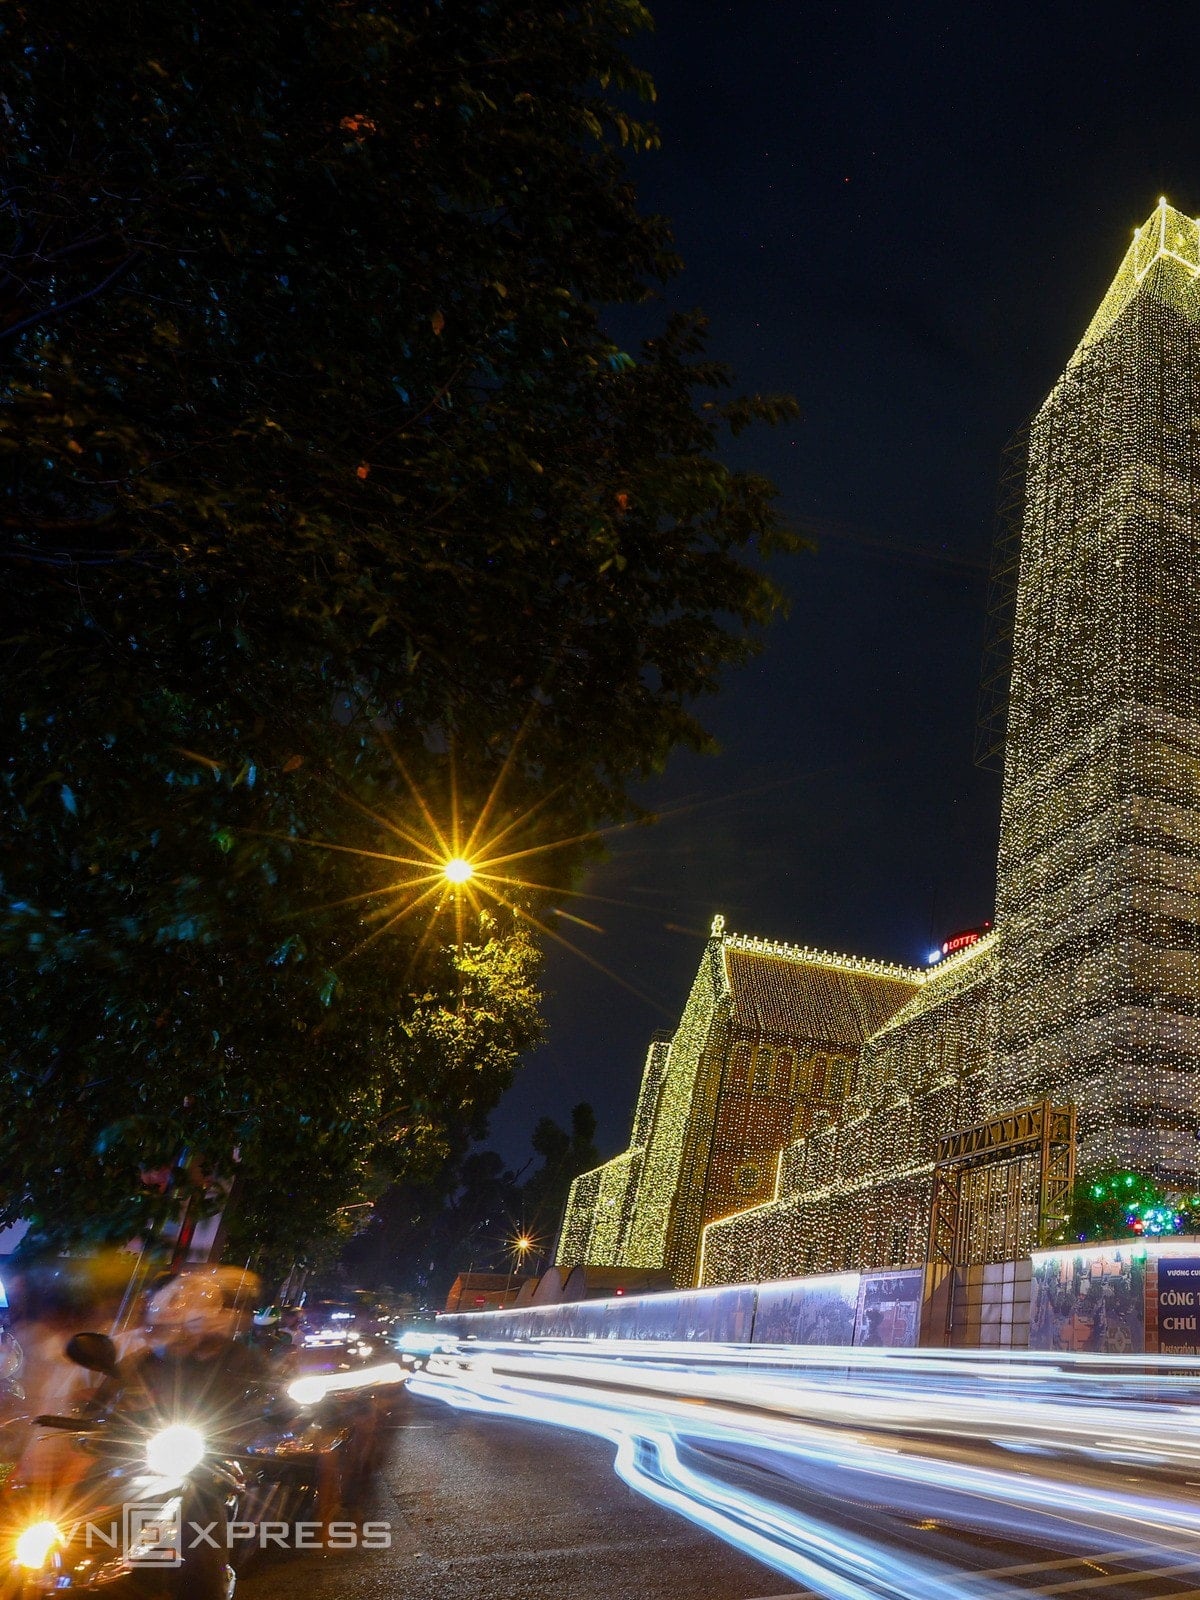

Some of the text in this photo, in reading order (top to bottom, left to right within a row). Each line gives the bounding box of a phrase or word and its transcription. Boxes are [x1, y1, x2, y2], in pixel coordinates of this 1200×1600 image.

[949, 934, 978, 950] LOTTE
[1160, 1289, 1194, 1306] CÔNG
[1163, 1314, 1197, 1330] CHÚ
[1160, 1342, 1195, 1355] Restoration
